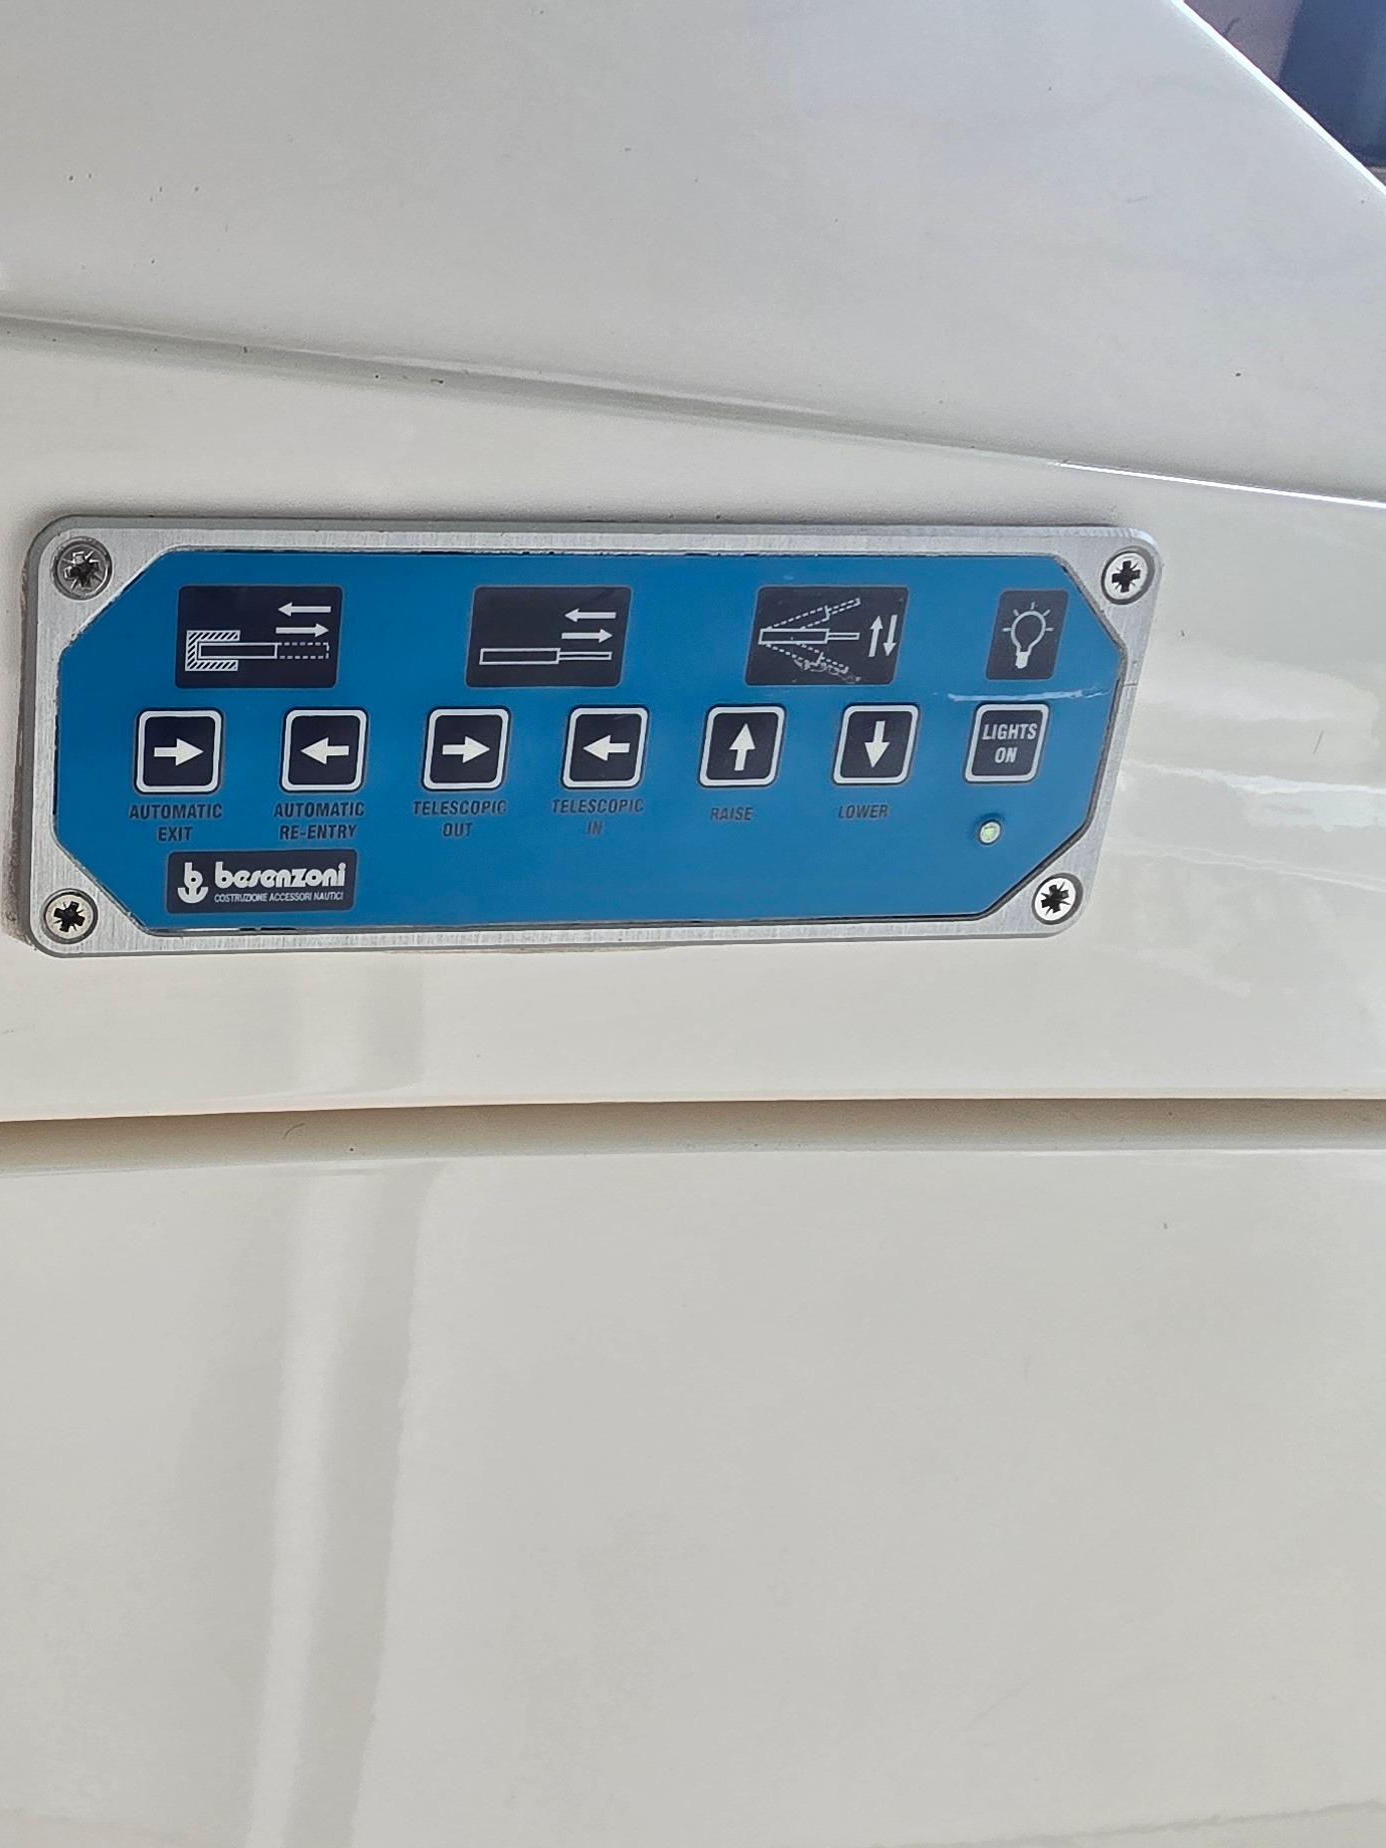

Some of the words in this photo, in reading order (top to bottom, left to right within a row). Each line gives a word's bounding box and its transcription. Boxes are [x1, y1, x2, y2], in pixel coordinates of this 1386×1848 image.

[982, 723, 1038, 741] LIGHTS
[994, 747, 1017, 764] ON
[129, 802, 223, 820] AUTOMATIC
[273, 800, 366, 819] AUTOMATIC
[412, 799, 507, 817] TELESCOPIC
[552, 797, 644, 816] TELESCOPIC
[710, 806, 753, 822] RAISE
[837, 803, 888, 820] LOWER
[158, 825, 194, 842] EXIT
[279, 823, 357, 841] RE-ENTRY
[442, 821, 473, 838] OUT
[587, 820, 603, 836] IN
[214, 861, 347, 889] besenzoni
[269, 892, 312, 903] ACCESSORI
[313, 891, 344, 902] NAUTICI
